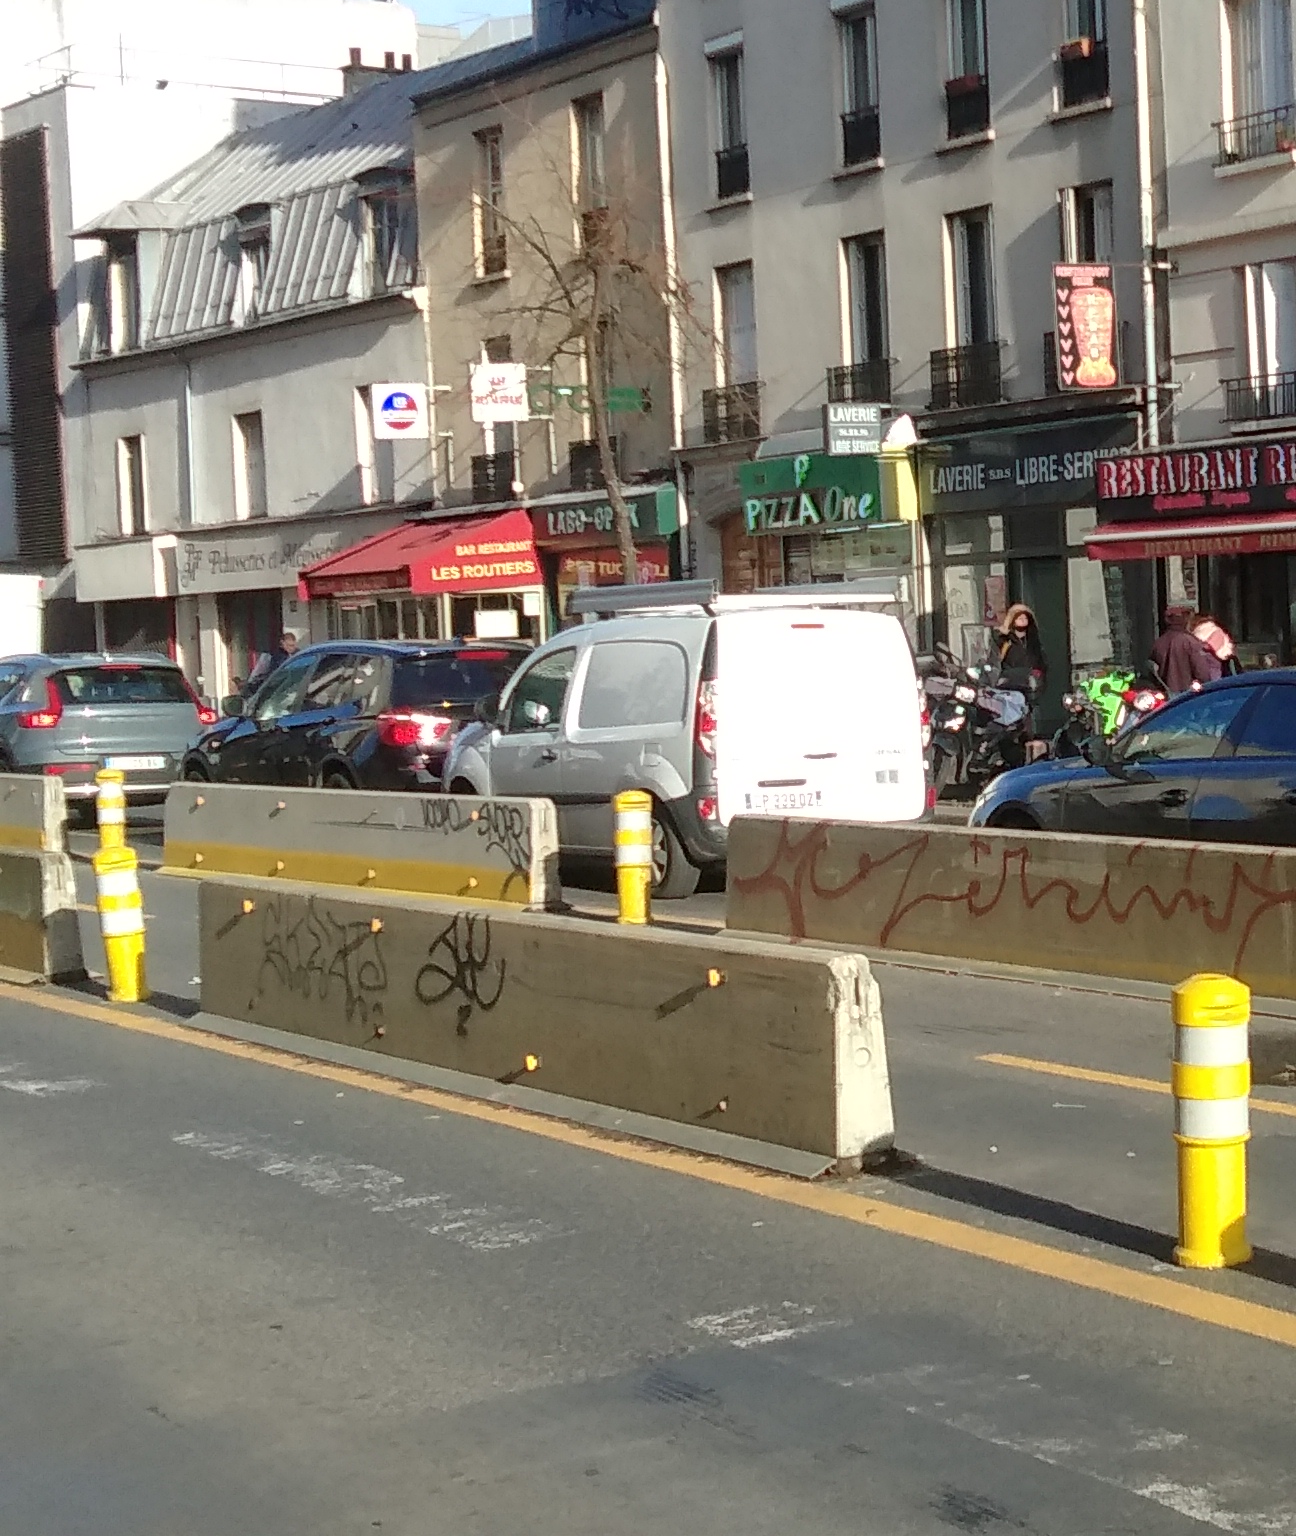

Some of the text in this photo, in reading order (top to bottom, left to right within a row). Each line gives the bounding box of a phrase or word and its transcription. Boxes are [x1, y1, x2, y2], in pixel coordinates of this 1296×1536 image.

[829, 406, 878, 423] LAVERIE
[929, 462, 987, 495] LAVERIE
[1100, 446, 1259, 500] RESTAURANT
[745, 485, 875, 532] PIZZA One
[455, 540, 533, 557] BAR RESTAURANT
[1143, 537, 1245, 556] RESTAURANT
[431, 560, 536, 581] LES ROUTIERS
